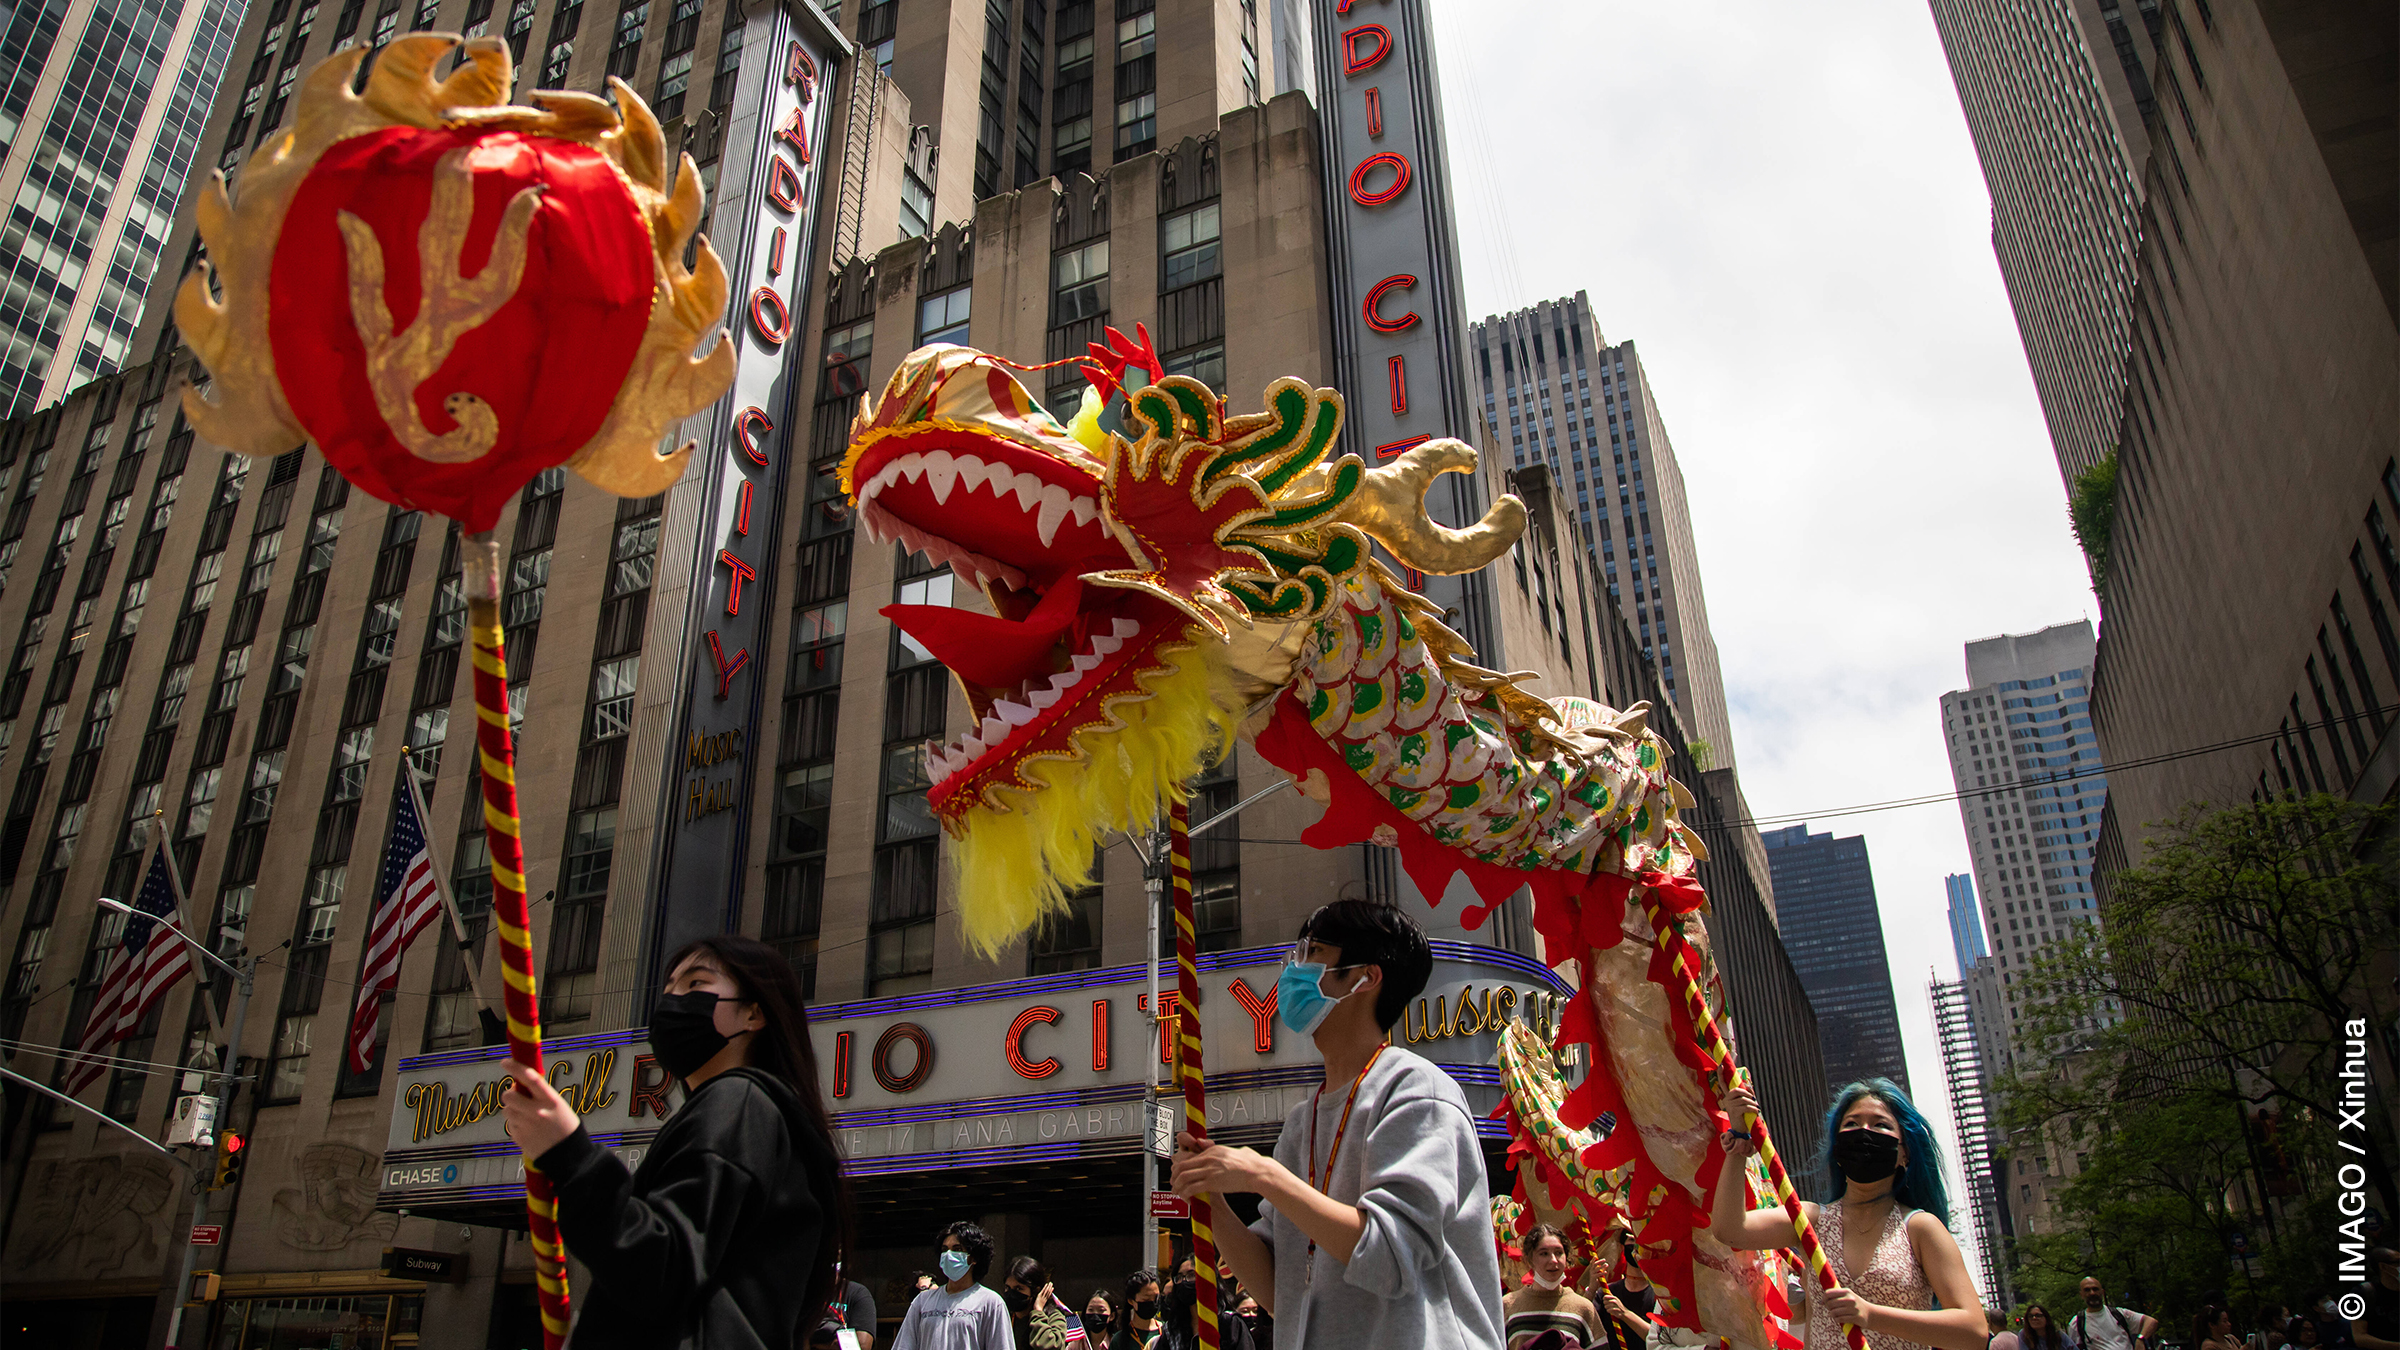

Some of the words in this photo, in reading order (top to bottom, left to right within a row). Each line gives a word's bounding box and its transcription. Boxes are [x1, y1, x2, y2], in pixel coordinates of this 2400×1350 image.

[1336, 0, 1412, 206] DIO
[751, 40, 819, 344] RADIO
[705, 406, 775, 700] CITY
[687, 775, 735, 823] HALL
[628, 1021, 935, 1121] RIO
[1389, 984, 1517, 1046] usic
[886, 1126, 913, 1152] 17
[954, 1115, 1015, 1147] ANA
[1038, 1104, 1142, 1139] GABRI
[1209, 1091, 1273, 1125] SAT
[1160, 1120, 1168, 1129] BOX
[389, 1167, 442, 1187] CHASE
[406, 1256, 442, 1273] Subway
